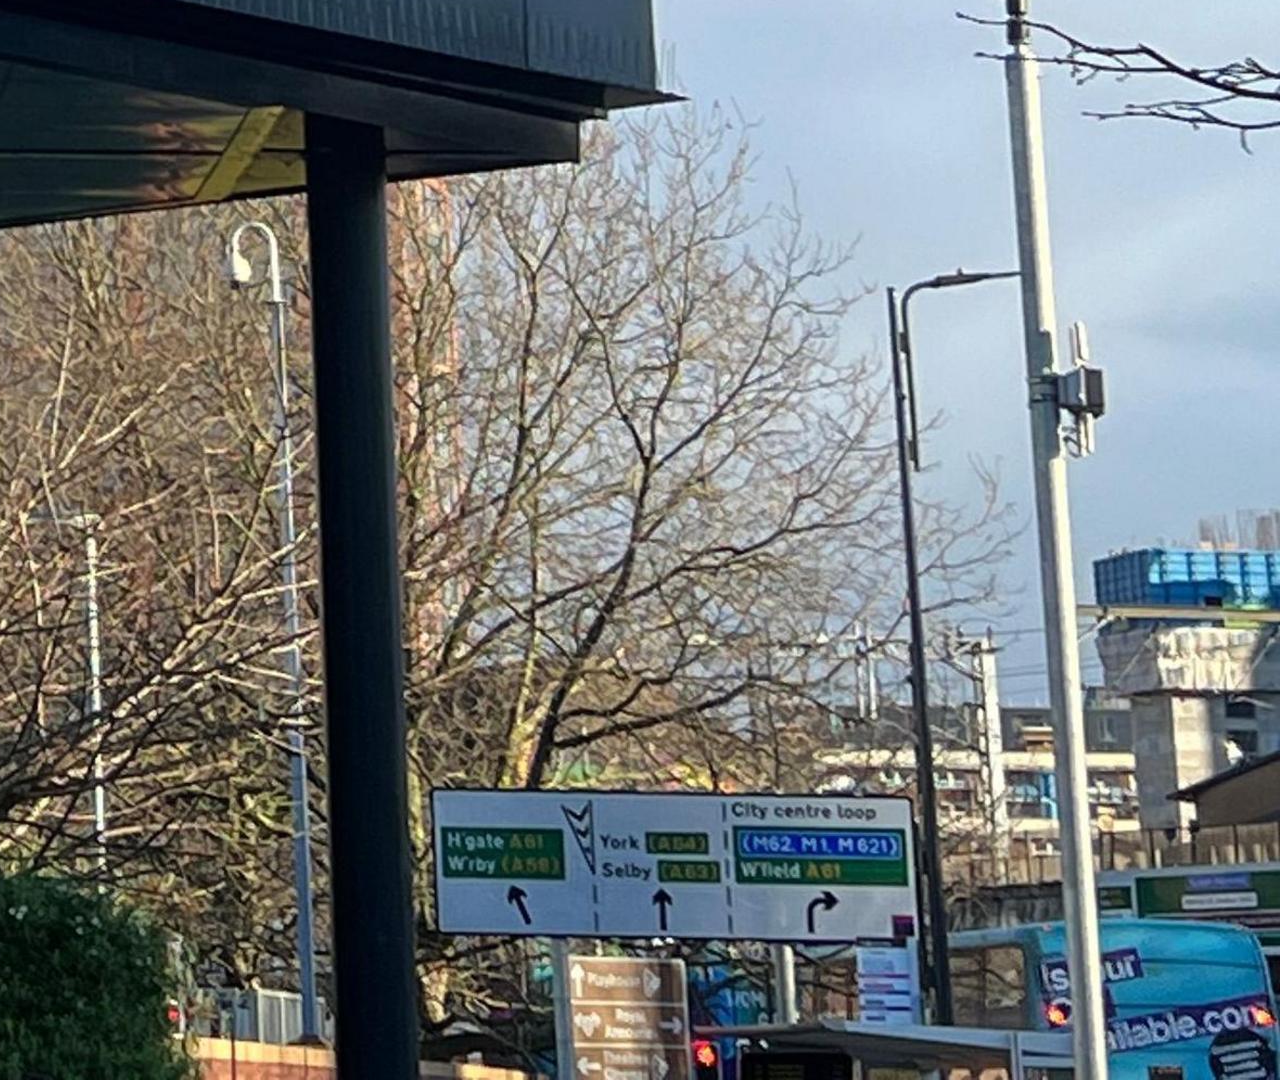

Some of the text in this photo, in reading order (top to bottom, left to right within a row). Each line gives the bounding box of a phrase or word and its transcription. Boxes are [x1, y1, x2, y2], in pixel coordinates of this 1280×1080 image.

[731, 801, 877, 821] City centre loop
[600, 834, 640, 851] York
[602, 862, 652, 881] Selby
